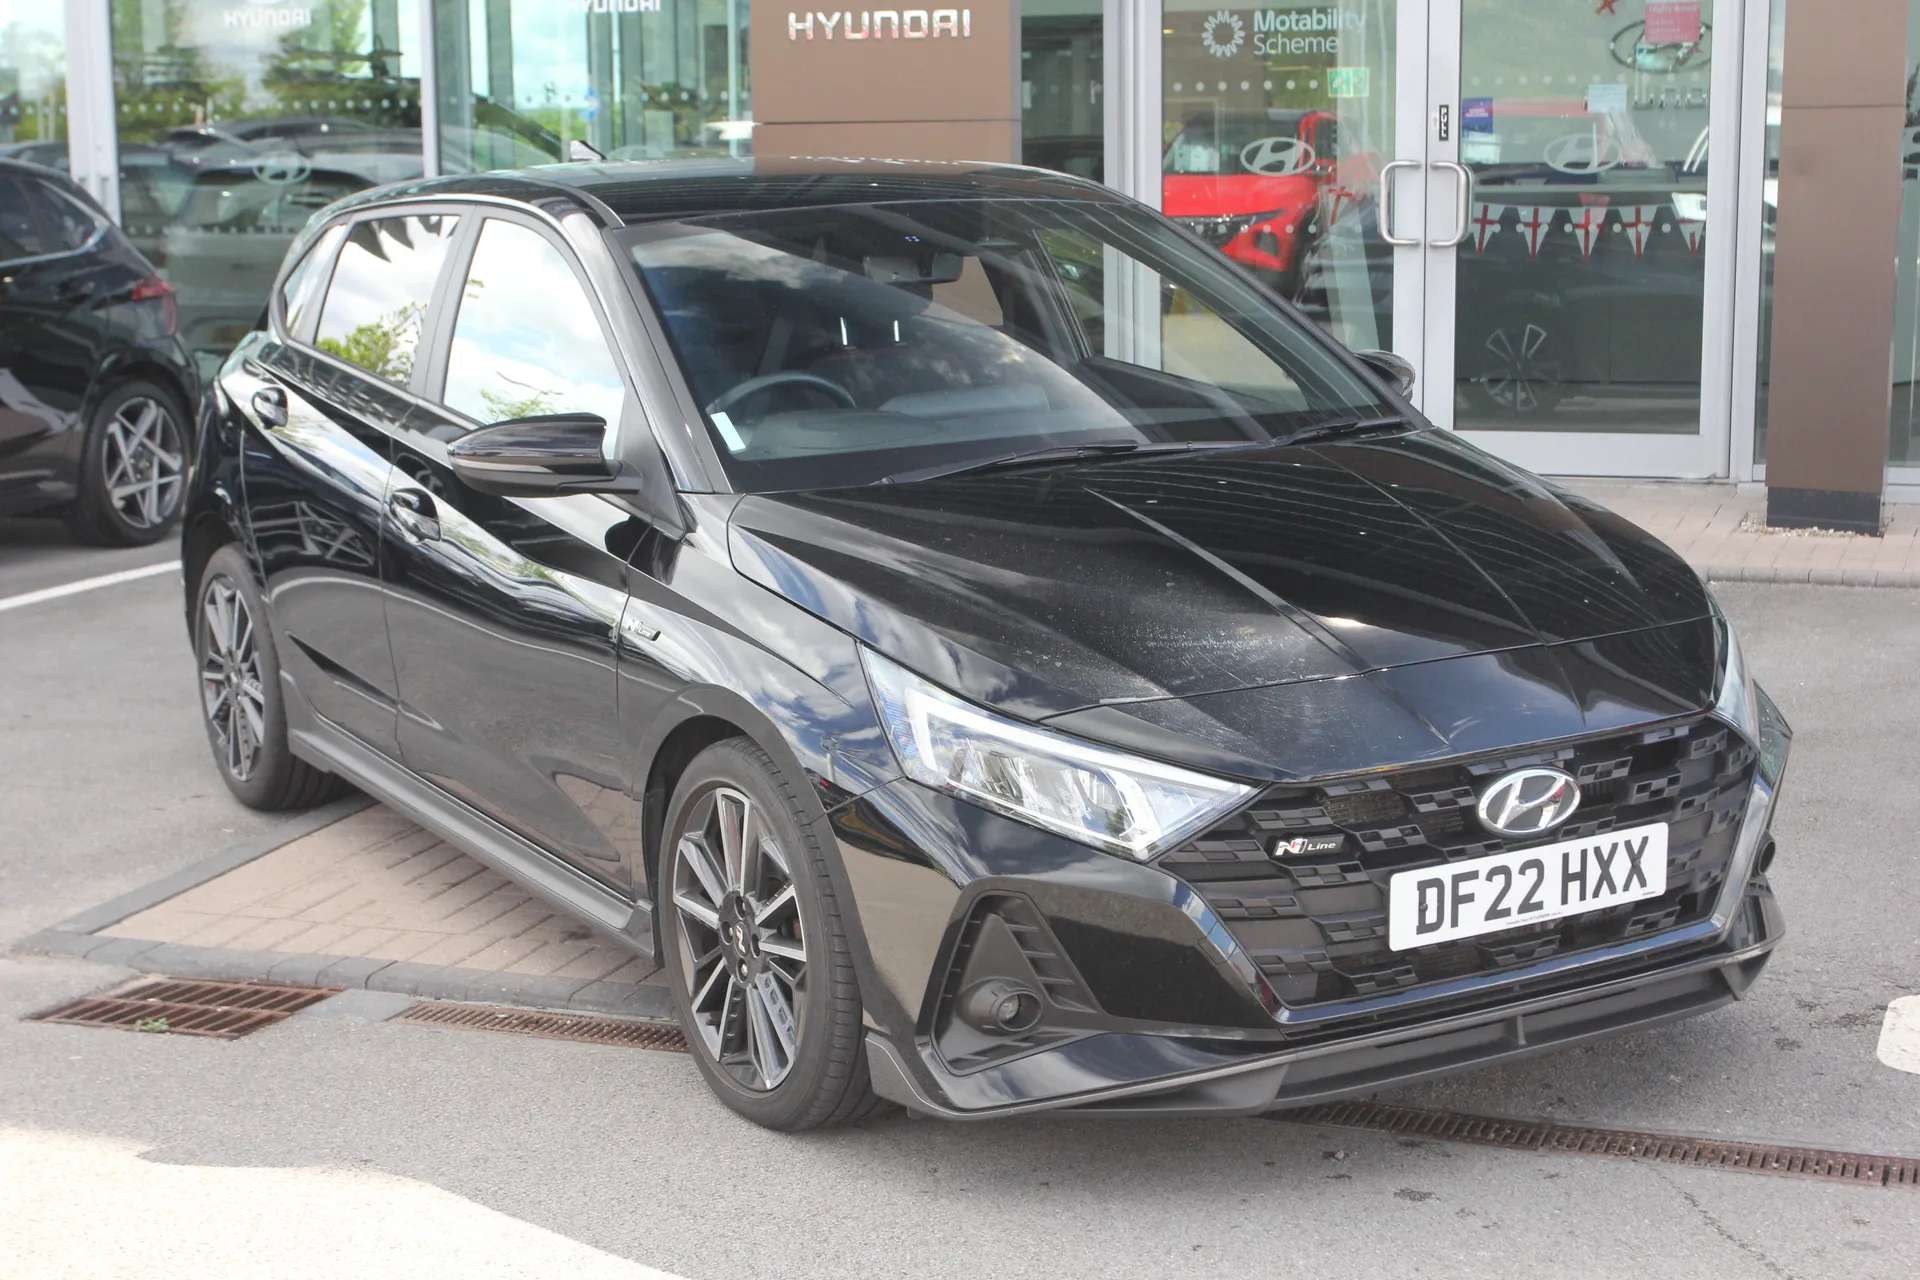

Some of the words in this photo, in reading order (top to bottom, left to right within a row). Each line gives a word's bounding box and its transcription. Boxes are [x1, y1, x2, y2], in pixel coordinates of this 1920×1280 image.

[223, 8, 312, 27] HYUNDAI
[788, 9, 971, 40] HYUNDAI
[1253, 8, 1365, 32] Motability
[1253, 33, 1340, 55] Scheme
[1440, 106, 1448, 138] PULL
[1307, 842, 1337, 851] Line
[1416, 858, 1545, 935] DF22
[1560, 836, 1649, 906] HXX
